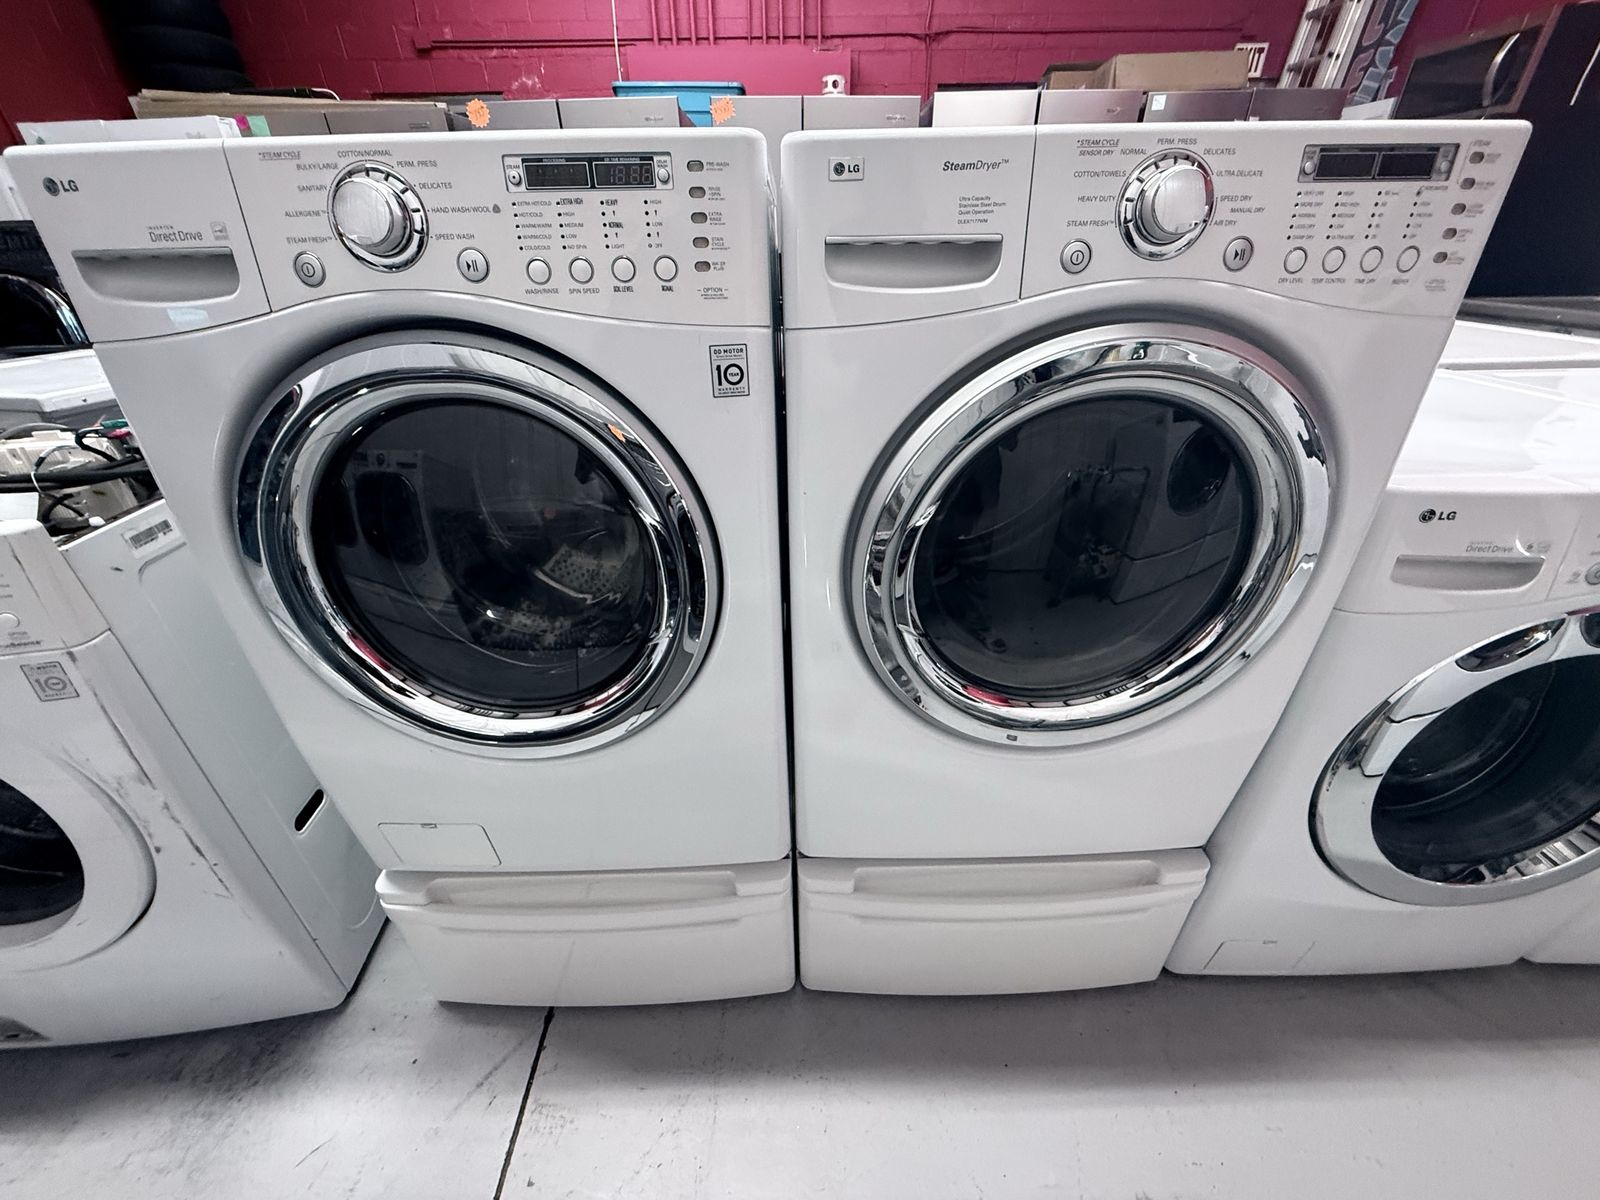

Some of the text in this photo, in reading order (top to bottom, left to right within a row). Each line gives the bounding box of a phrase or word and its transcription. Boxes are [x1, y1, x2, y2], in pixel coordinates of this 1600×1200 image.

[1237, 46, 1266, 74] IT
[1101, 138, 1120, 146] CYCLE
[282, 151, 301, 160] CYCLE
[337, 149, 392, 158] COTTON/NORMAL
[1120, 148, 1147, 156] NORMAL
[1203, 148, 1237, 156] DELICATES
[296, 163, 339, 171] BULKY/LARGE
[396, 160, 438, 168] PERM. PRESS
[847, 164, 860, 173] LG
[60, 179, 79, 193] LG
[297, 184, 328, 192] SANITARY
[418, 181, 453, 190] DELICATES
[431, 205, 491, 213] HAND WASH/WOOL
[149, 230, 204, 243] Direct Drive
[286, 236, 309, 244] STEAM
[435, 233, 475, 241] SPEED WASH
[622, 285, 634, 293] LEVEL
[715, 363, 744, 387] 10
[1437, 511, 1457, 521] LG
[1465, 545, 1491, 553] Direct
